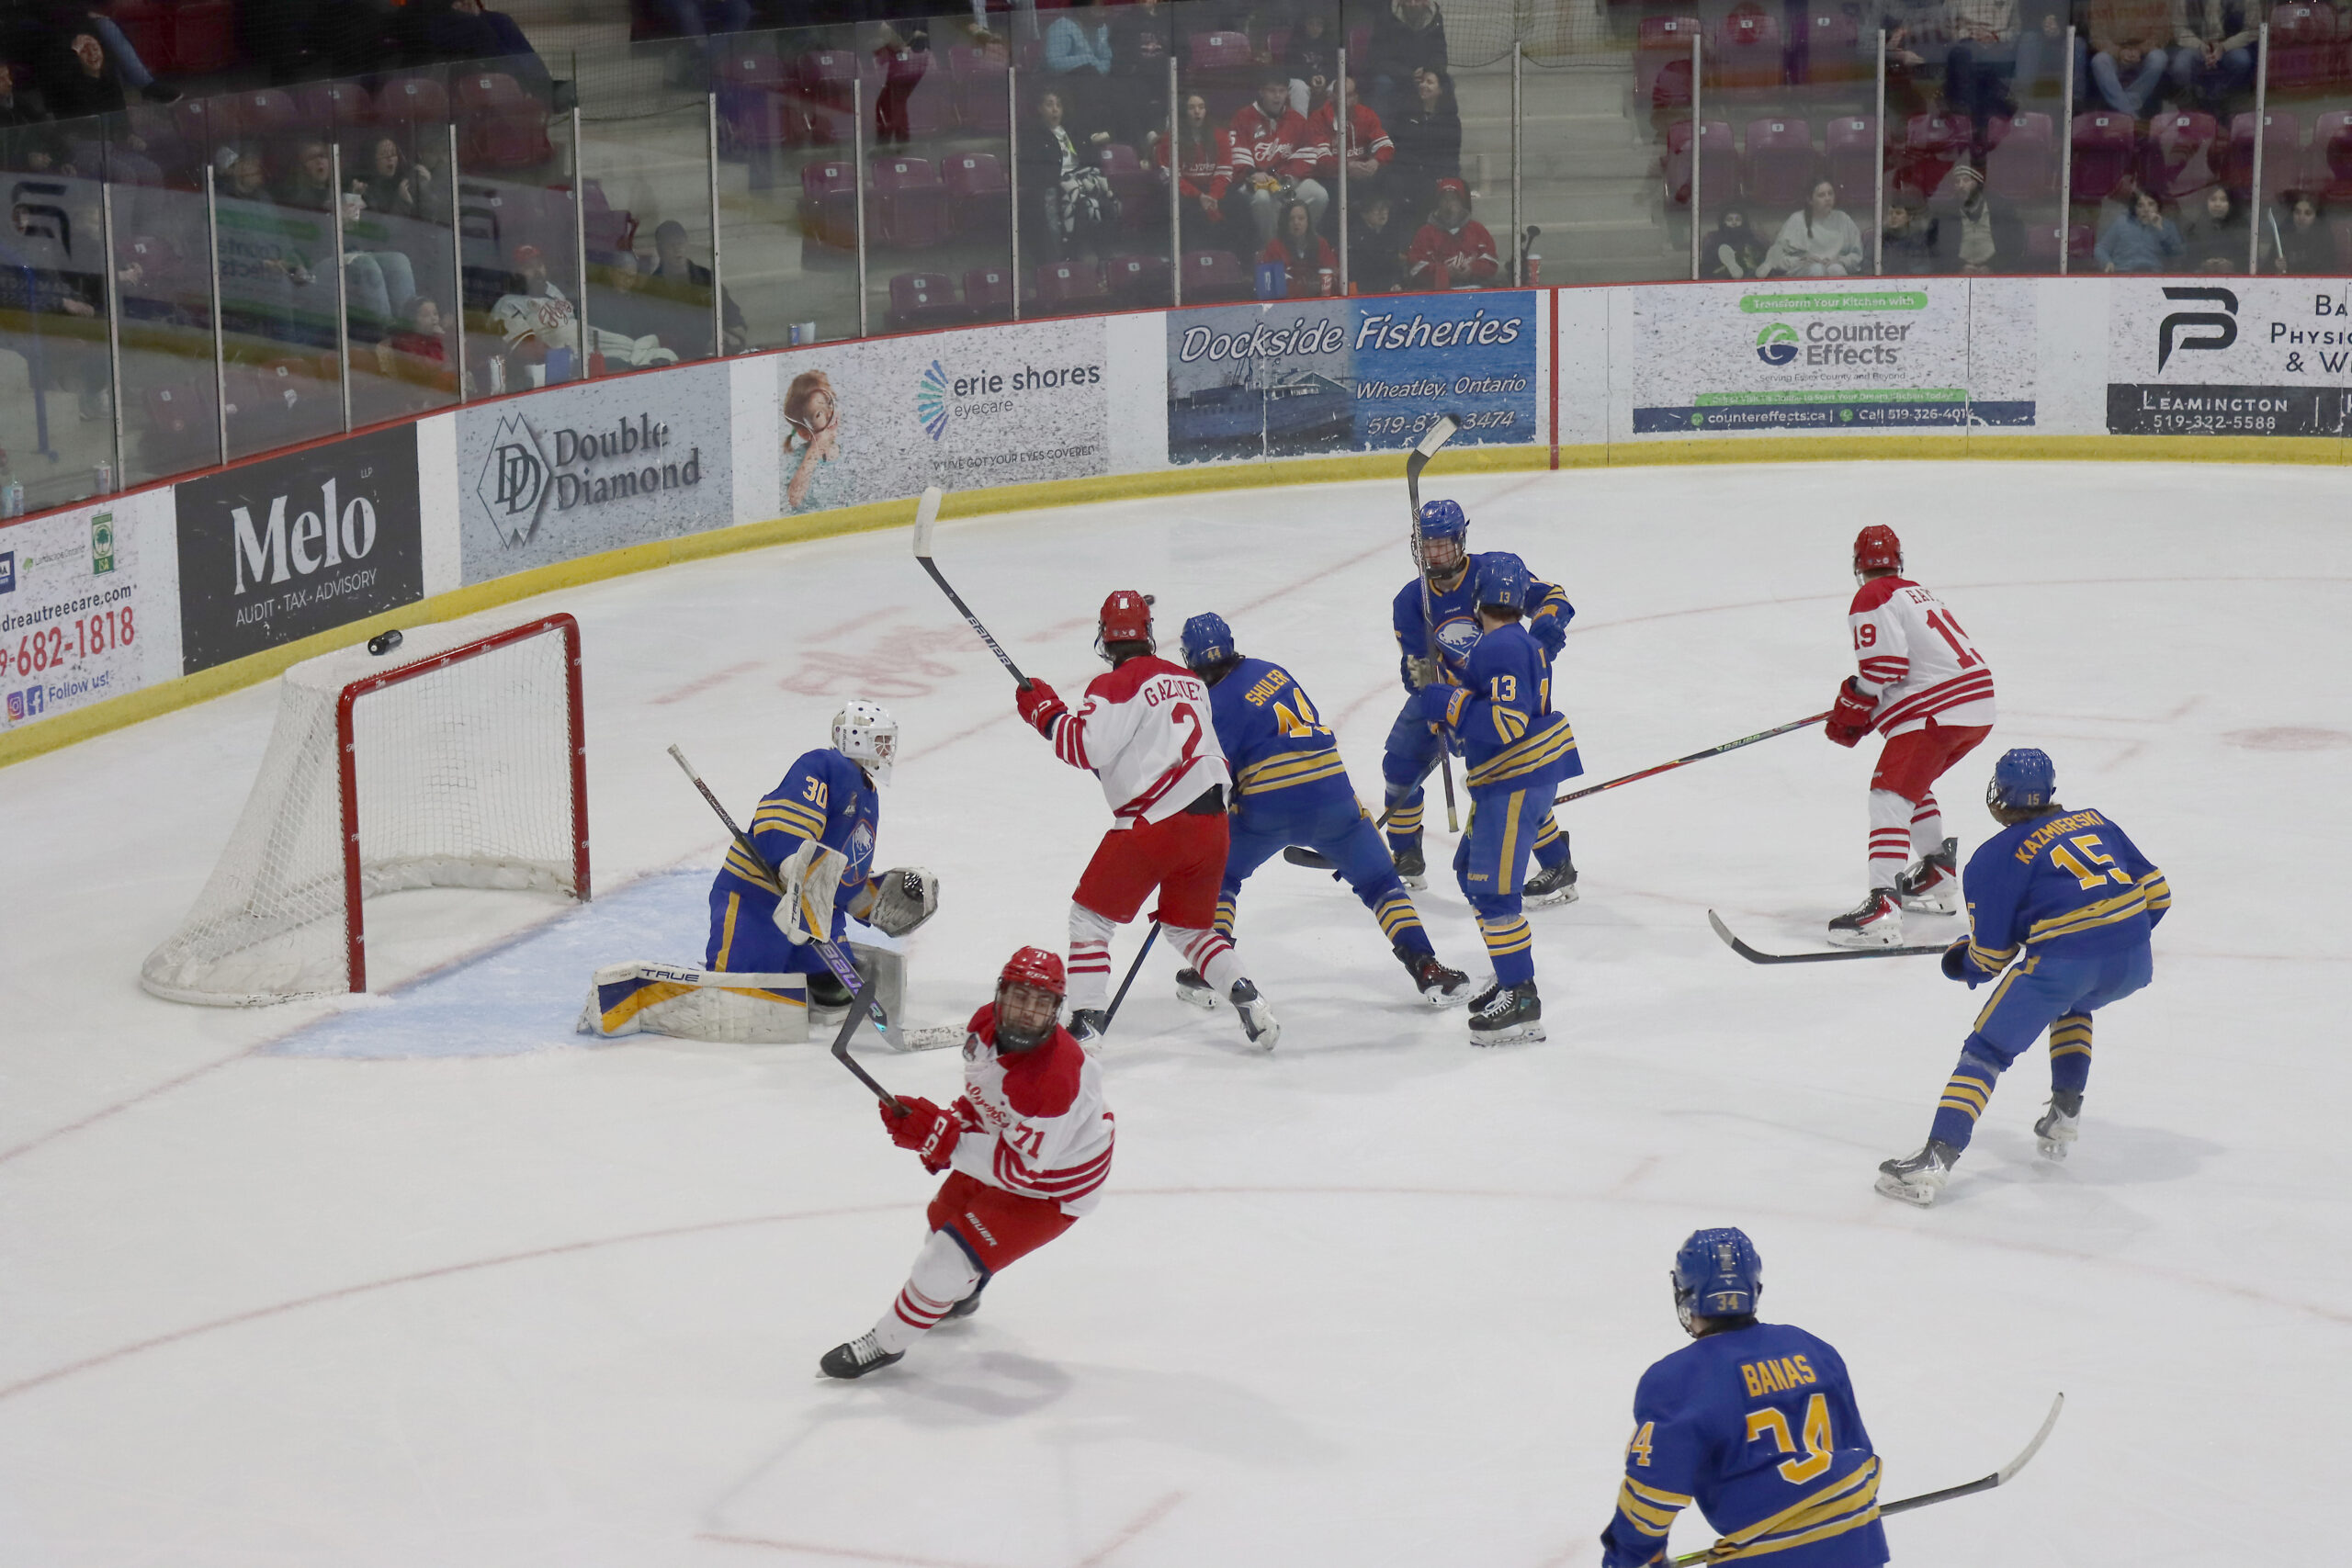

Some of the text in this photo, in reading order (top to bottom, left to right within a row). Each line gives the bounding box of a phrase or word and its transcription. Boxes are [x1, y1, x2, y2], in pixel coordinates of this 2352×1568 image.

[1753, 296, 1915, 310] Transform Your Kitchen with
[1180, 309, 1522, 363] Dockside Fisheries
[1806, 321, 1912, 343] Counter
[1806, 344, 1898, 367] Effects
[2286, 351, 2352, 374] & W
[954, 366, 1101, 397] erie shores
[1356, 373, 1527, 401] Wheatley, Ontario
[1759, 371, 1906, 383] Serving Essex County and Beyond
[955, 400, 1013, 420] eyecare
[1367, 411, 1516, 435] 519-823474
[1708, 411, 1826, 423] countereffects.ca
[1859, 409, 1883, 420] Call
[2153, 414, 2277, 430] 519-322-5588
[553, 412, 669, 468] Double
[967, 457, 988, 468] GOT
[989, 453, 1018, 466] YOUR
[1020, 450, 1045, 462] EYES
[1046, 445, 1095, 459] COVERED
[360, 467, 373, 479] LLP
[555, 447, 702, 512] Diamond
[231, 477, 377, 595] Melo
[235, 568, 377, 627] AUDIT TAX ADVISORY
[1498, 592, 1510, 604] 13
[1853, 623, 1877, 650] 19
[1207, 647, 1221, 661] 44
[49, 671, 109, 703] Follow us!
[1244, 669, 1291, 707] SHULER
[1490, 675, 1516, 703] 13
[1170, 702, 1203, 764] 2
[802, 775, 829, 809] 30
[2027, 793, 2040, 806] 15
[2015, 810, 2106, 865] KAZMIERSKI
[2050, 834, 2136, 890] 15
[791, 882, 800, 925] TRUE
[1035, 951, 1047, 960] 71
[641, 968, 700, 983] TRUE
[1026, 970, 1049, 980] CCM
[1012, 1122, 1046, 1159] 71
[965, 1213, 998, 1247] BAUER
[1716, 1293, 1739, 1312] 34
[1741, 1355, 1817, 1398] BANAS
